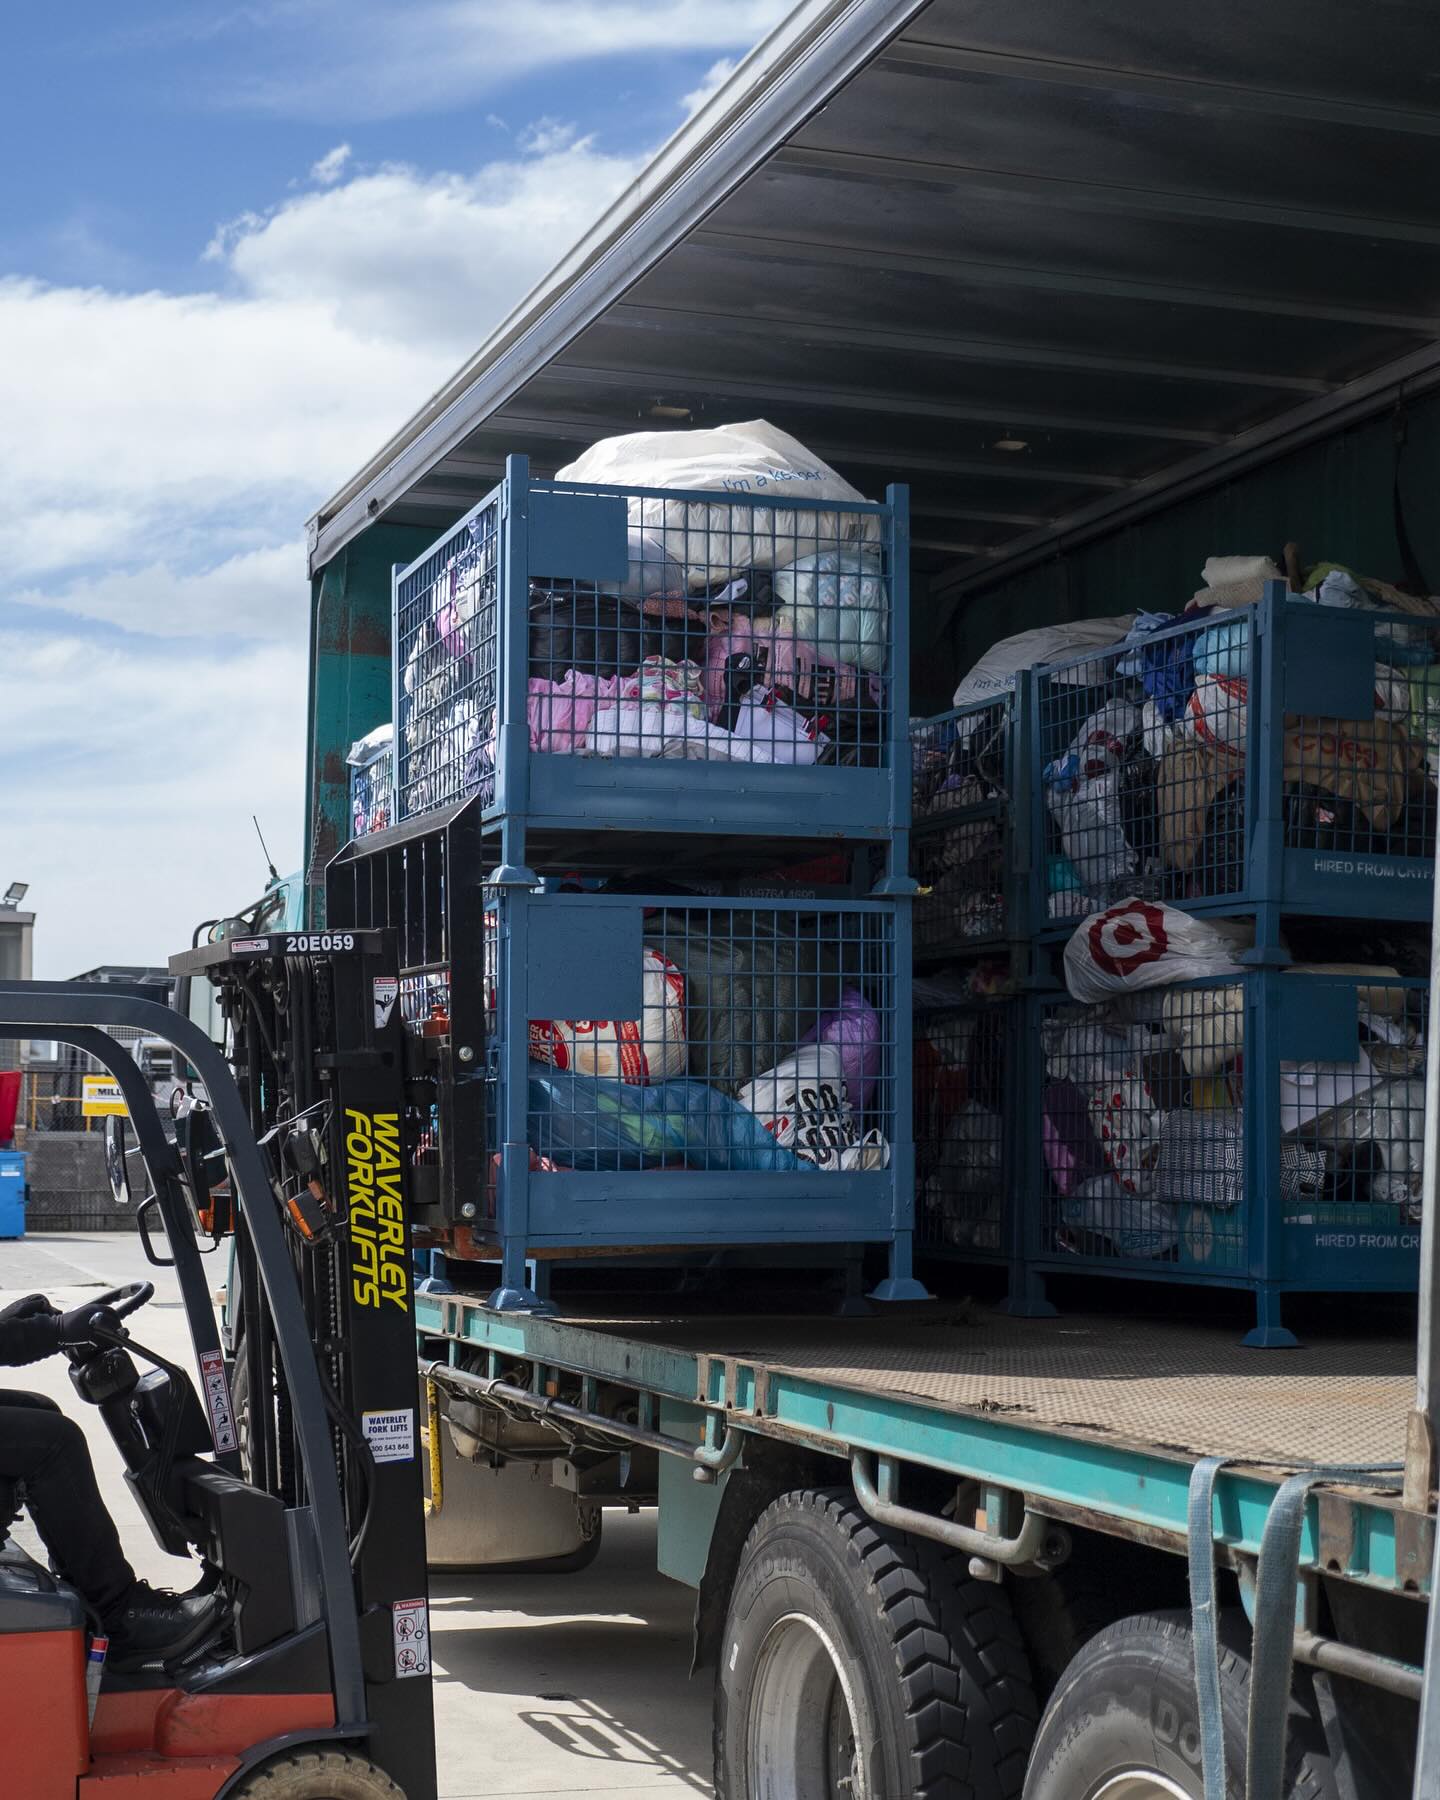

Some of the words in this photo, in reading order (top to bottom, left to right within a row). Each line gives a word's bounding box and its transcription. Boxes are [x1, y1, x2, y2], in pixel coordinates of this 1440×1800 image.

[721, 479, 751, 492] I'm
[755, 474, 767, 487] a
[1314, 858, 1354, 874] HIRED
[1357, 861, 1394, 877] FROM
[286, 935, 354, 952] 20E059
[97, 1088, 122, 1096] MILL
[345, 1108, 380, 1309] FORKLIFTS
[373, 1113, 408, 1313] WAVERLEY
[1315, 1234, 1356, 1248] HIRED
[1359, 1234, 1397, 1248] FROM
[368, 1415, 408, 1425] WAVERLEY
[368, 1425, 388, 1434] FORK
[390, 1424, 408, 1433] LIFTS
